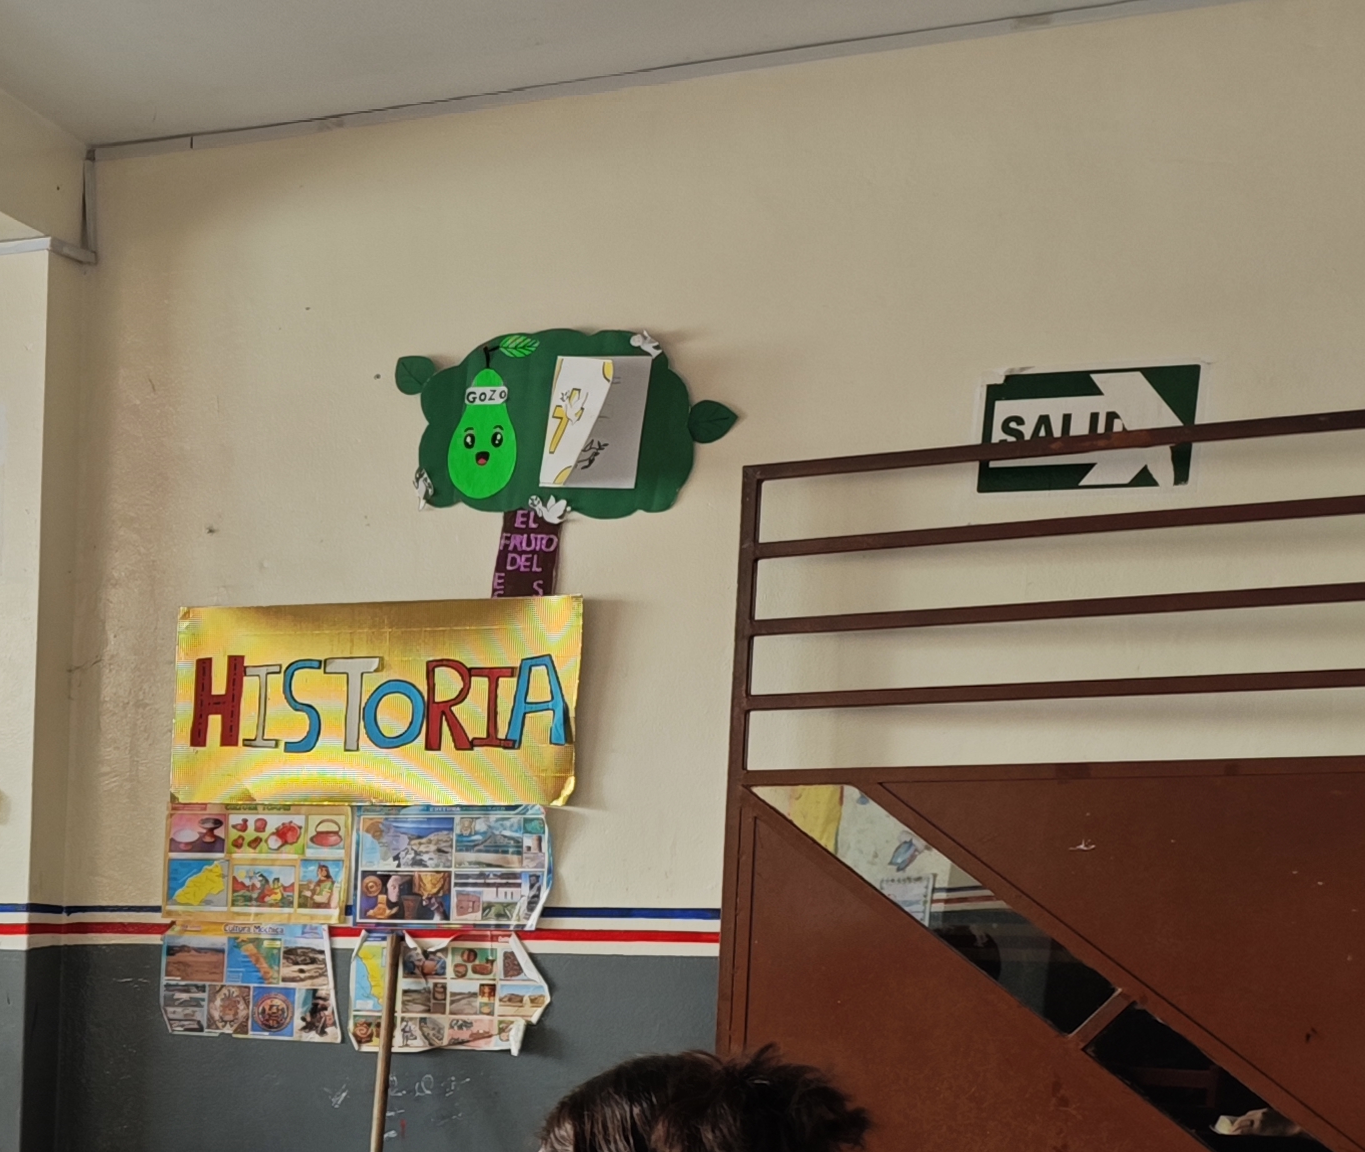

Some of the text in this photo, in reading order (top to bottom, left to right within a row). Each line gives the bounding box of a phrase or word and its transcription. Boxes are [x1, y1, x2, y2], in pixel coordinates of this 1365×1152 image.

[466, 389, 507, 404] GOZO
[514, 510, 539, 529] EL
[499, 533, 559, 552] FRUTO
[506, 553, 542, 572] DEL
[189, 653, 570, 753] HISTORIA
